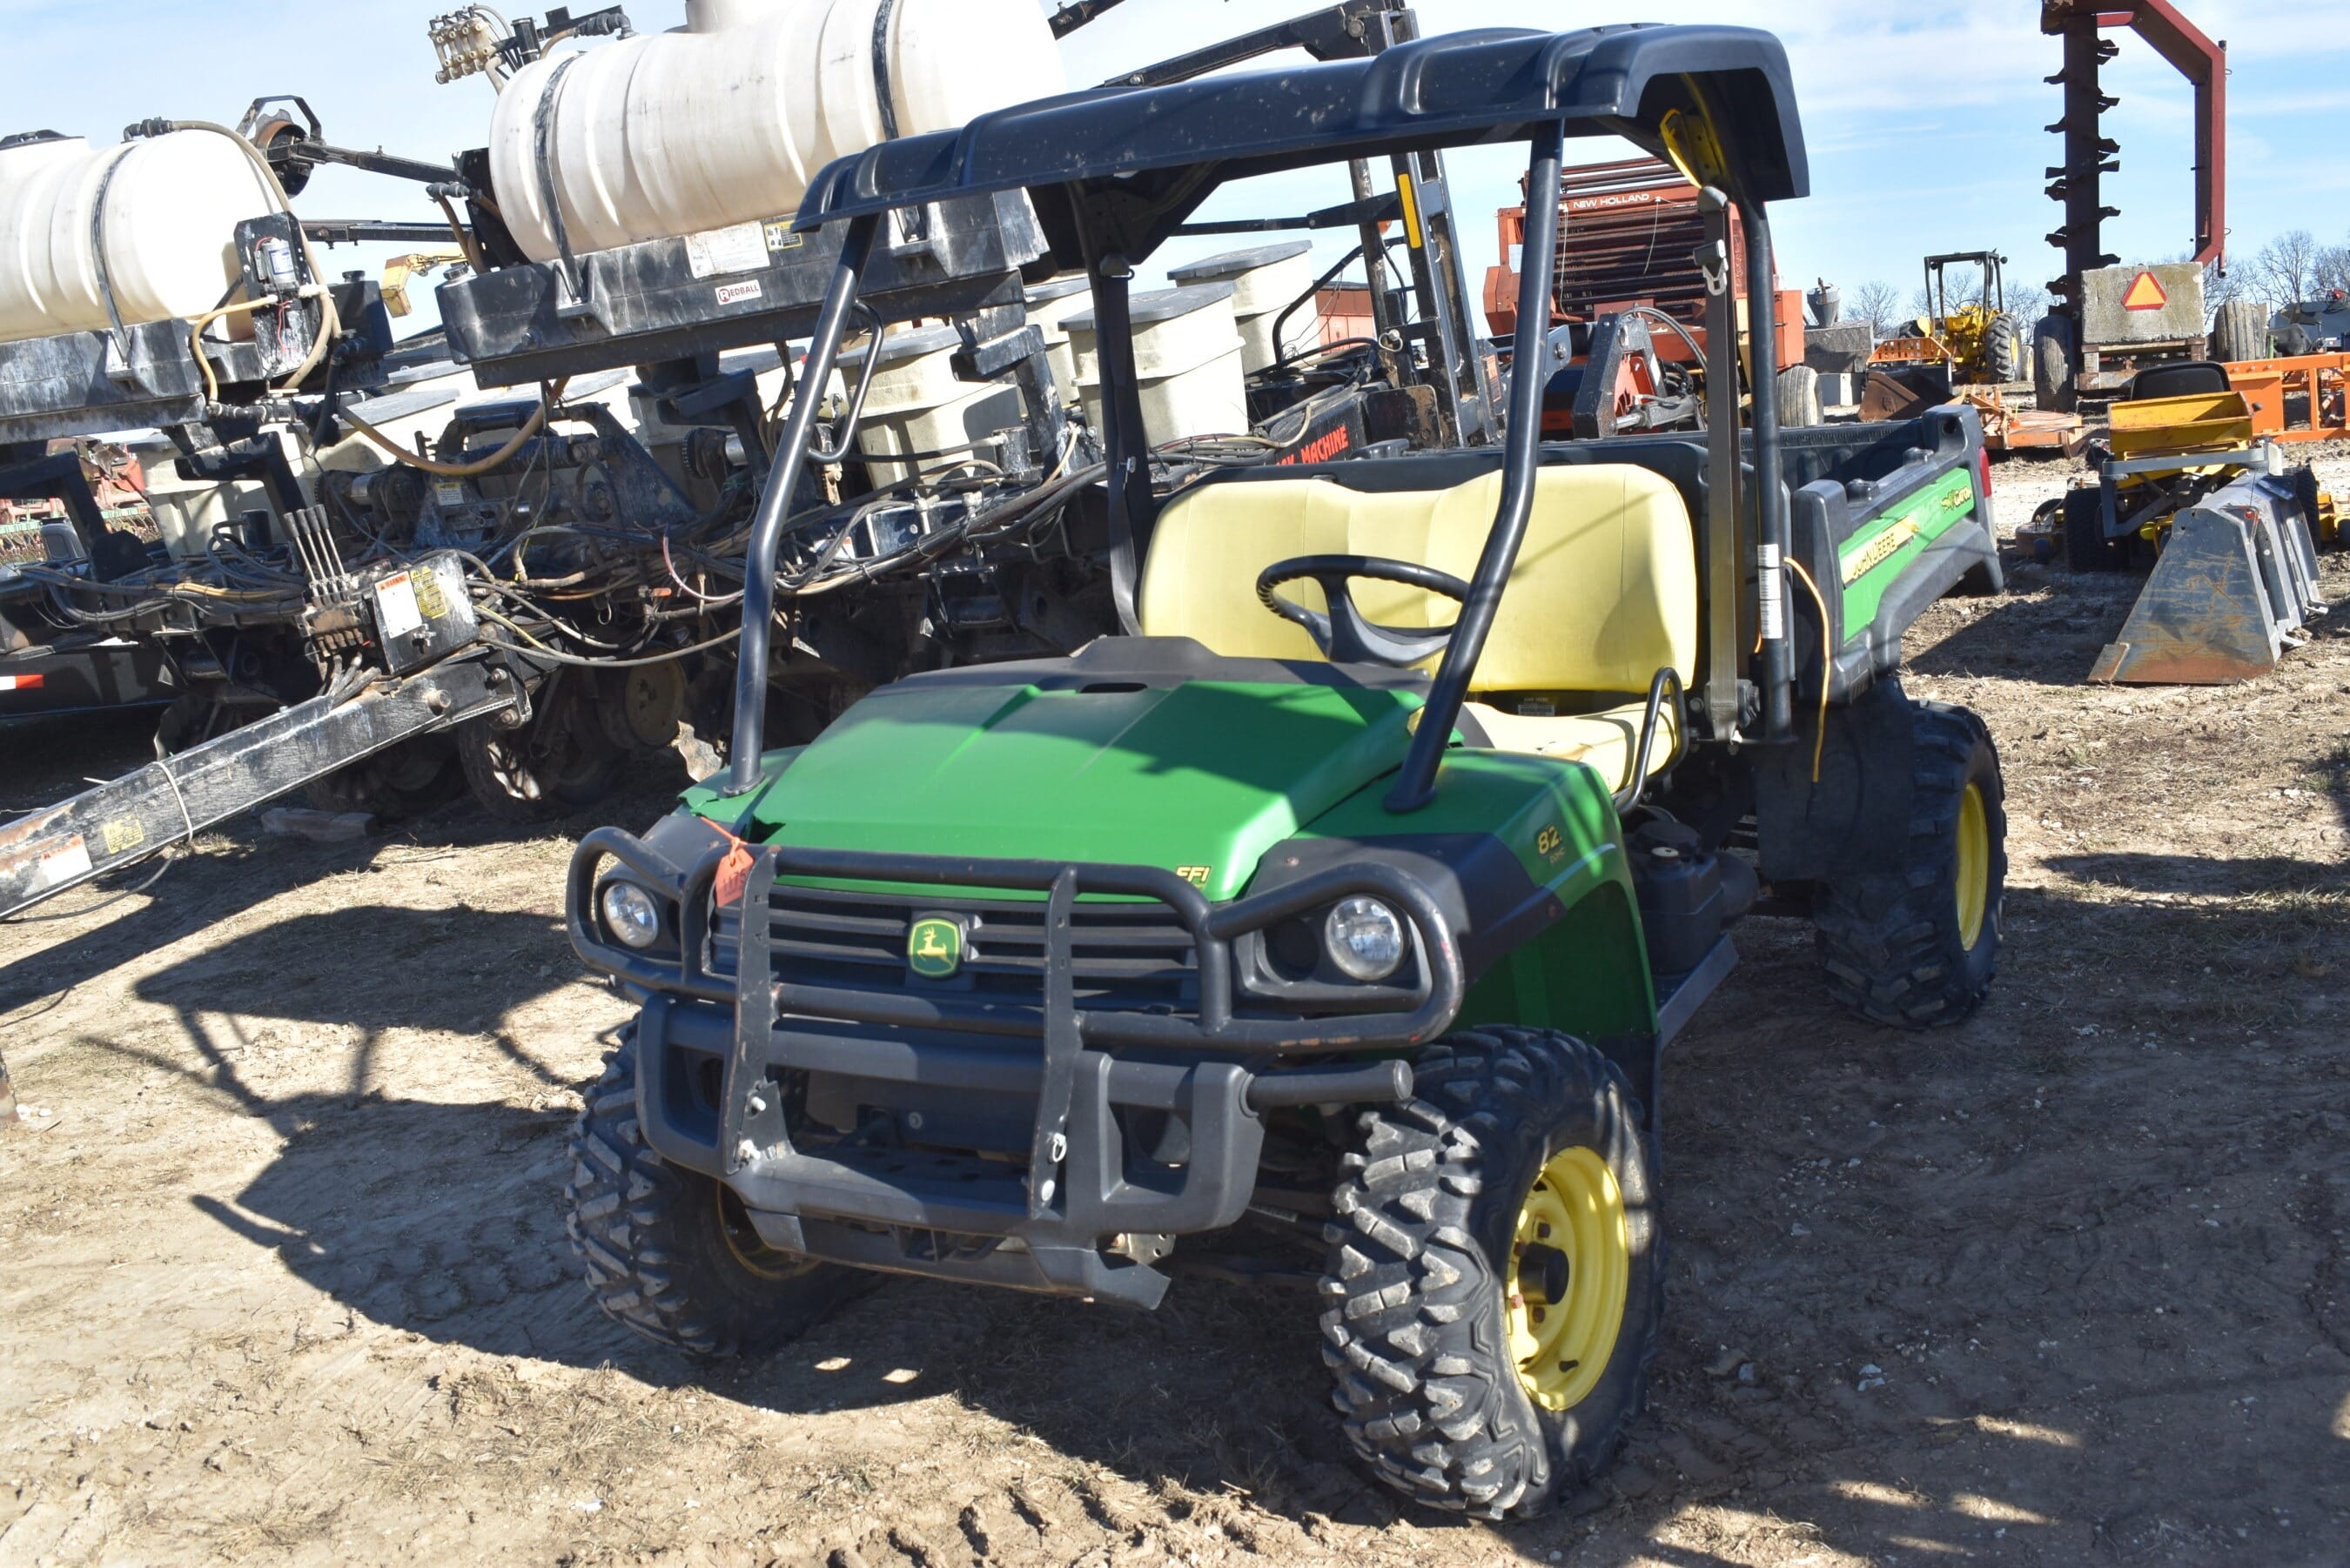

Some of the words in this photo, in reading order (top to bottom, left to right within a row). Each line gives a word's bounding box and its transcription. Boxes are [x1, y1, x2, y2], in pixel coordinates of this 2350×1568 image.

[1573, 198, 1597, 209] NEW
[1600, 192, 1650, 206] HOLLAND
[718, 285, 760, 303] REDBALL
[1300, 424, 1349, 465] MACHINE
[1852, 549, 1874, 580] JOHN
[1872, 532, 1897, 565] DEERE
[1177, 866, 1211, 882] EFI
